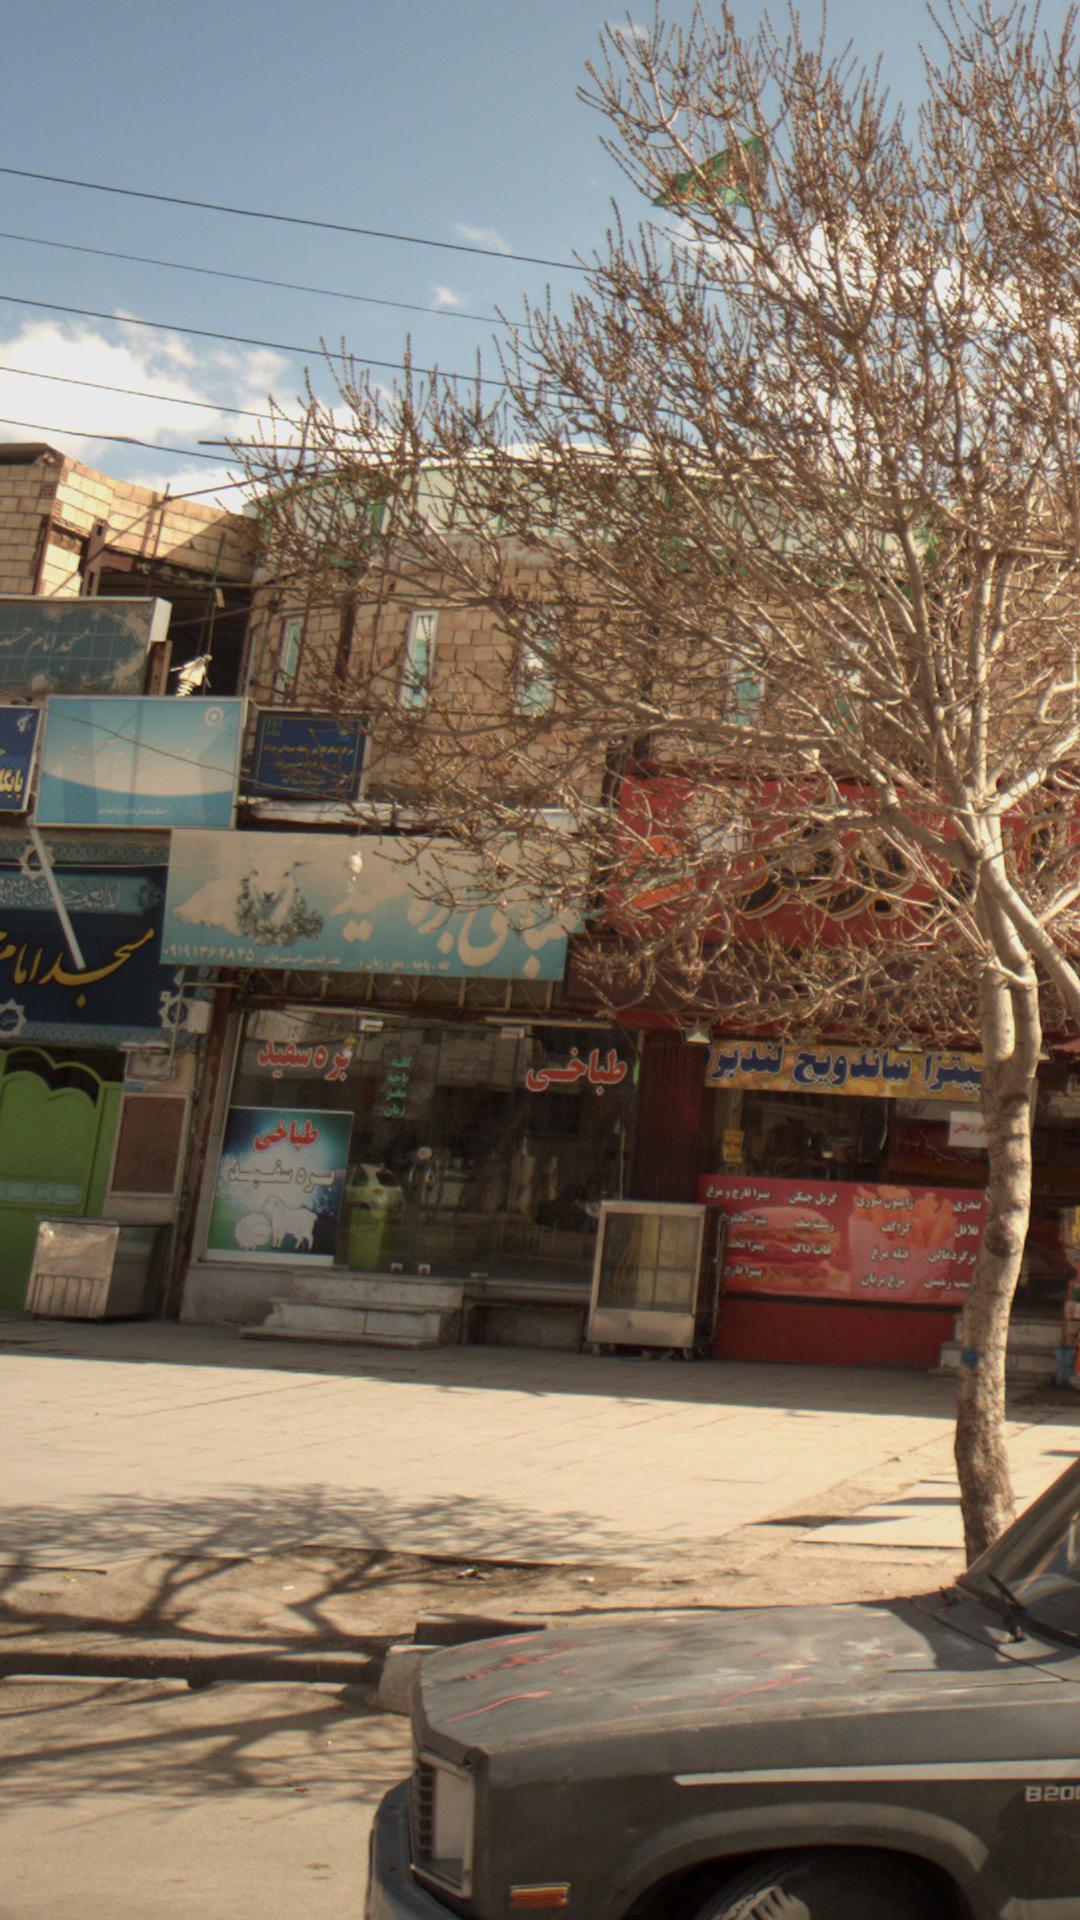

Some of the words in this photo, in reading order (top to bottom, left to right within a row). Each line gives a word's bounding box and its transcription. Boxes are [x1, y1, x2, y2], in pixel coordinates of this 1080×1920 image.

[38, 927, 156, 1009] مسجد
[257, 1040, 313, 1080] سفید
[312, 1045, 351, 1082] بره
[526, 1046, 629, 1097] طباخی
[703, 1042, 783, 1081] لندبر
[793, 1047, 912, 1087] ساندویچ
[253, 1118, 320, 1152] طباخی
[227, 1158, 294, 1189] سفید
[295, 1165, 336, 1194] بره
[953, 1221, 980, 1238] فلافل
